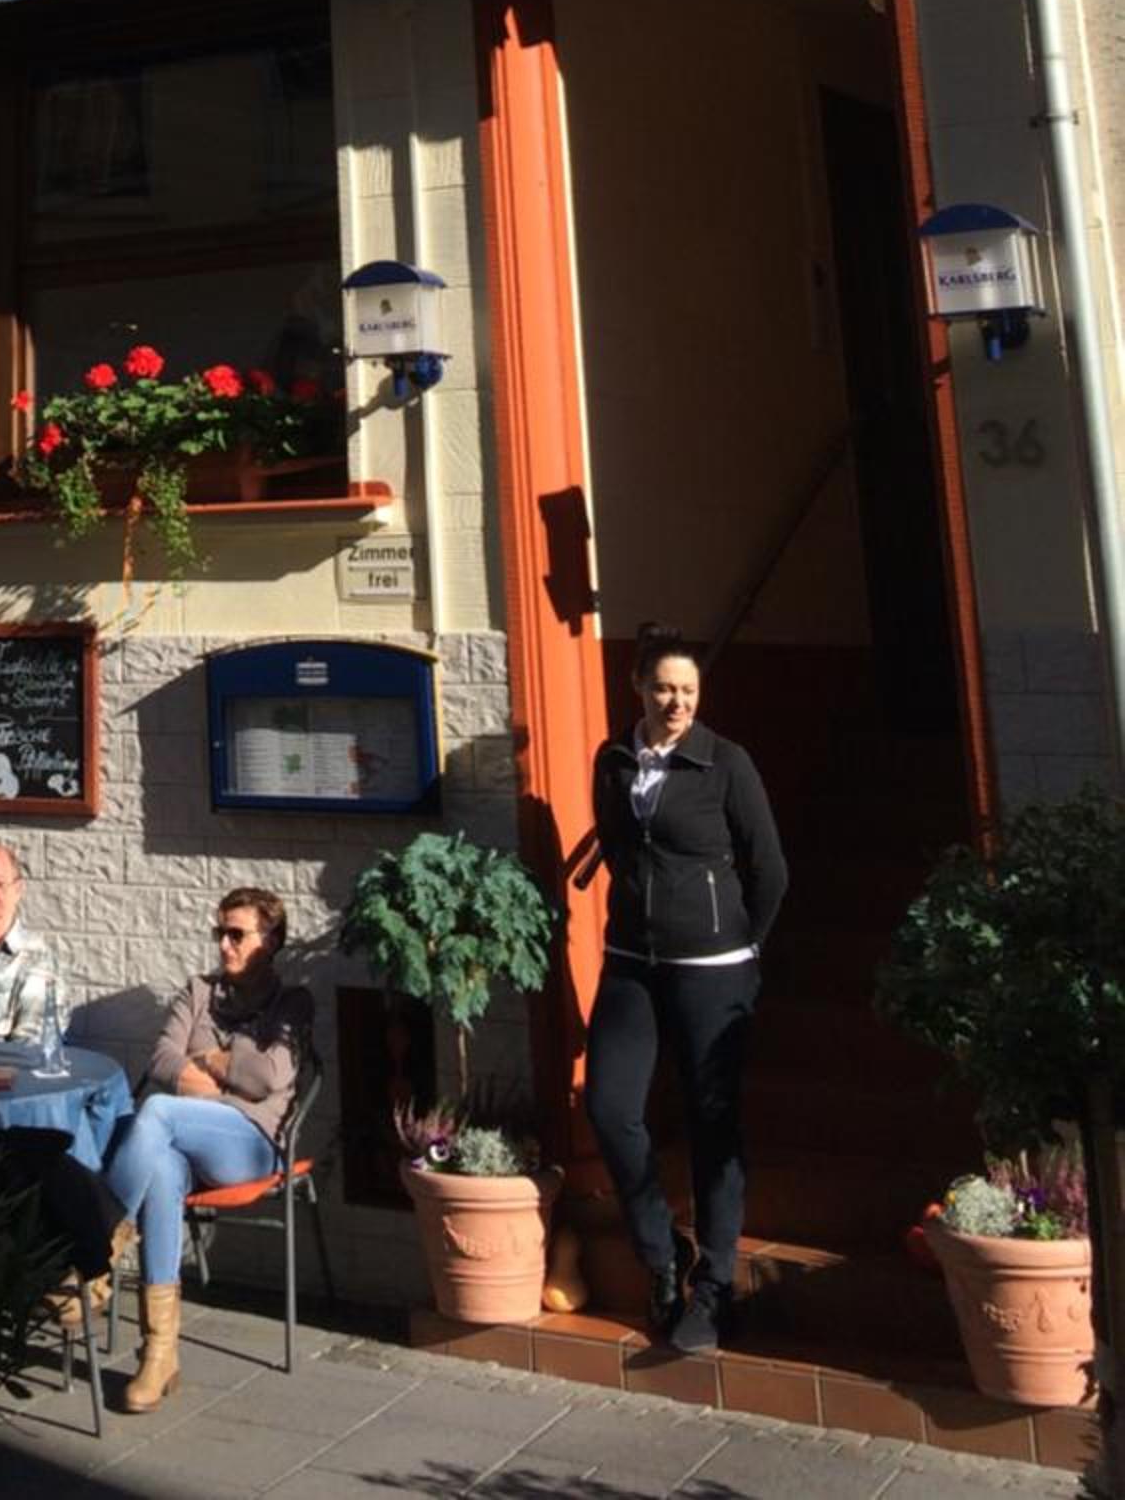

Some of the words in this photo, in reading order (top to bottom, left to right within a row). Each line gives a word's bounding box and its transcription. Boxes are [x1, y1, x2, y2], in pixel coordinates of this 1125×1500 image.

[938, 266, 1017, 288] KARLSBERG
[978, 418, 1047, 468] 36
[367, 570, 399, 589] frei
